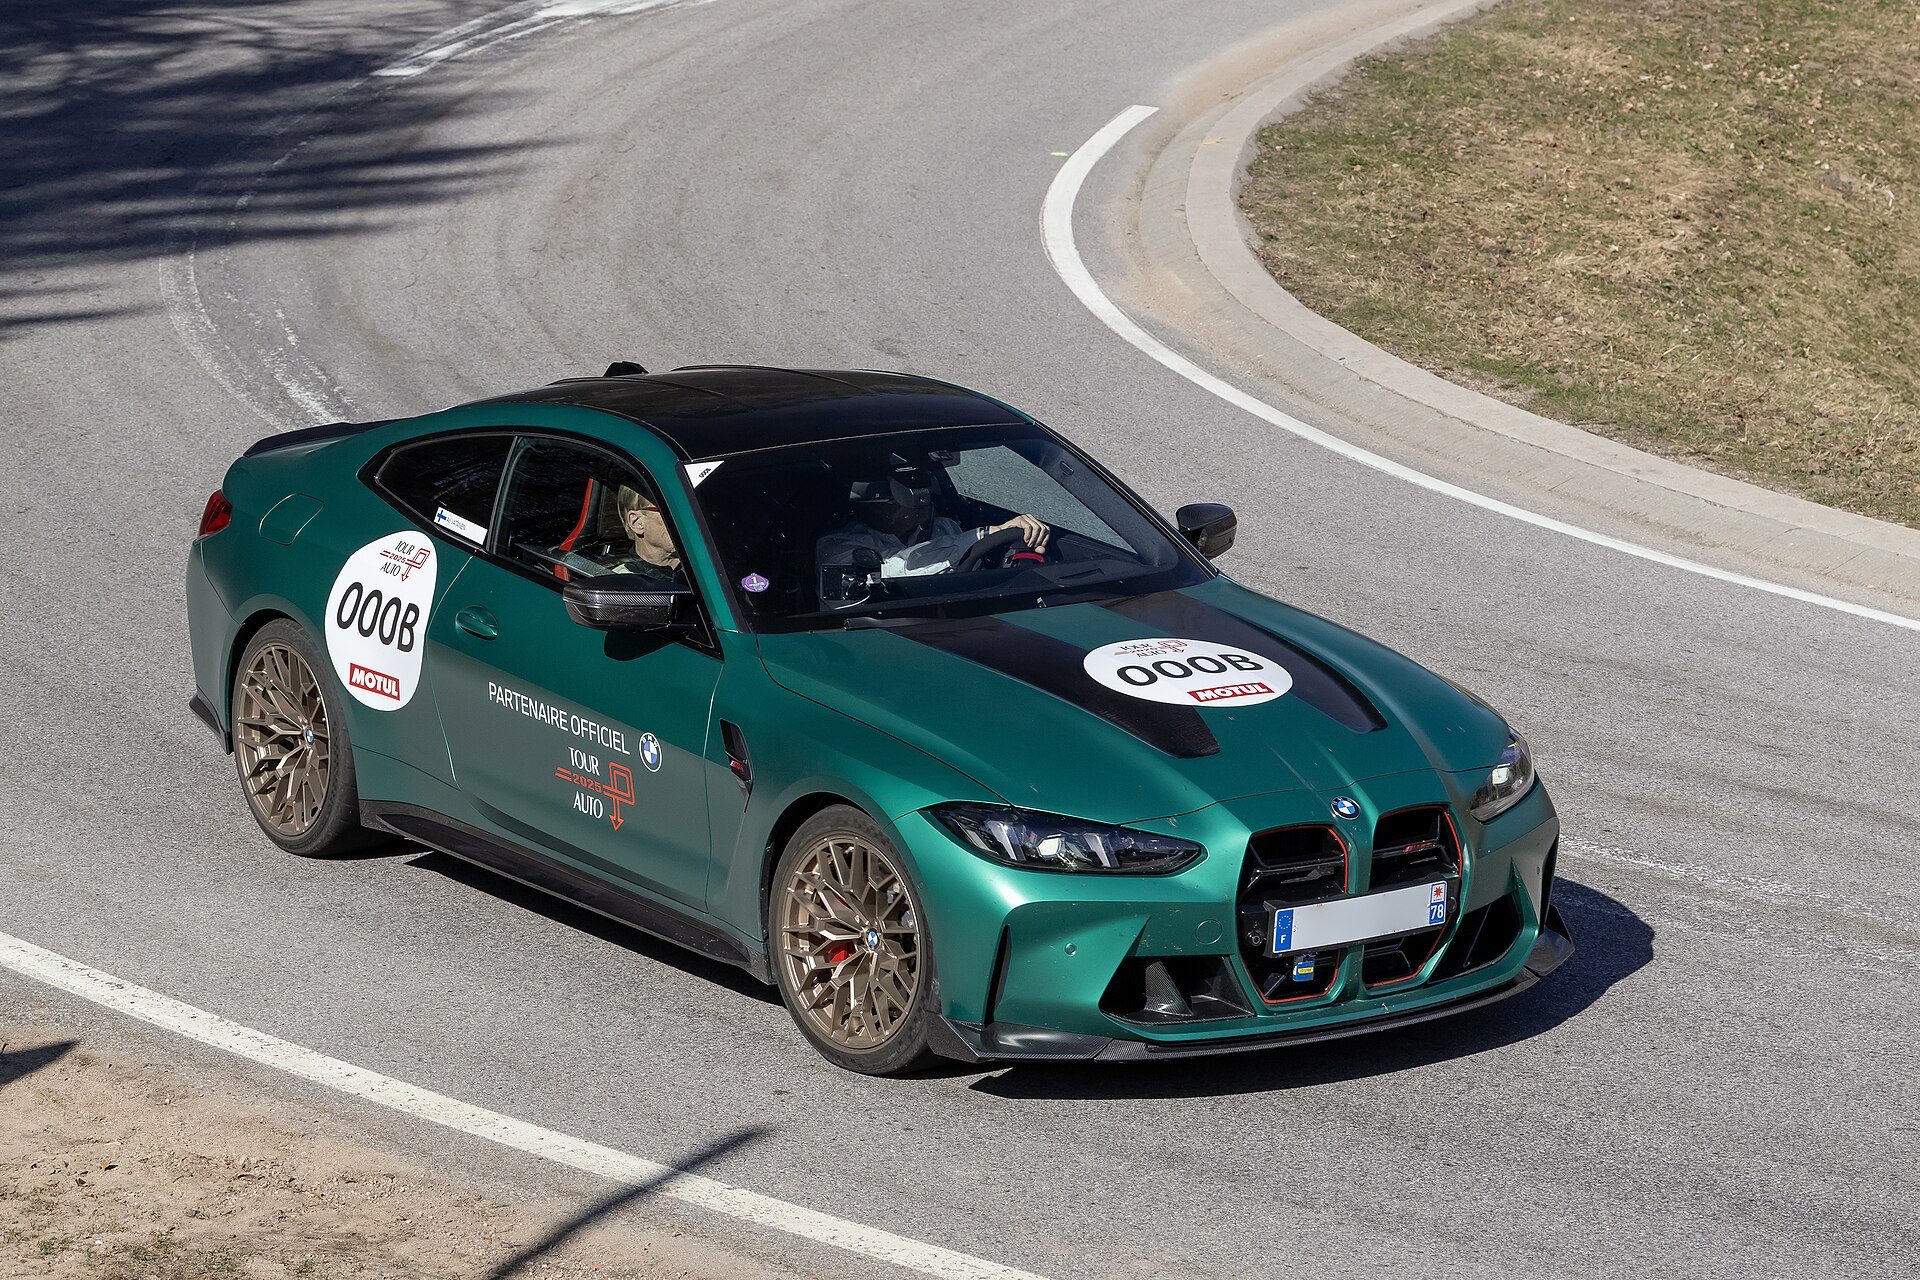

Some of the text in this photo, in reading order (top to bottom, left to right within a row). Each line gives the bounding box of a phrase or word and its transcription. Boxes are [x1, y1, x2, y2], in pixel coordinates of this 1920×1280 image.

[394, 540, 415, 556] TOUR
[389, 552, 406, 564] 2025
[380, 561, 401, 577] AUTO
[336, 581, 420, 653] 000B
[1136, 649, 1167, 658] AUTO
[1116, 653, 1265, 687] 000B
[351, 667, 399, 697] MOTUL
[1195, 683, 1269, 701] MOTUL
[488, 681, 631, 755] PARTENAIRE OFFICIEL
[568, 746, 600, 776] TOUR
[571, 773, 603, 794] 2025
[572, 790, 604, 819] AUTO
[1430, 903, 1444, 920] 78
[1280, 934, 1287, 944] F
